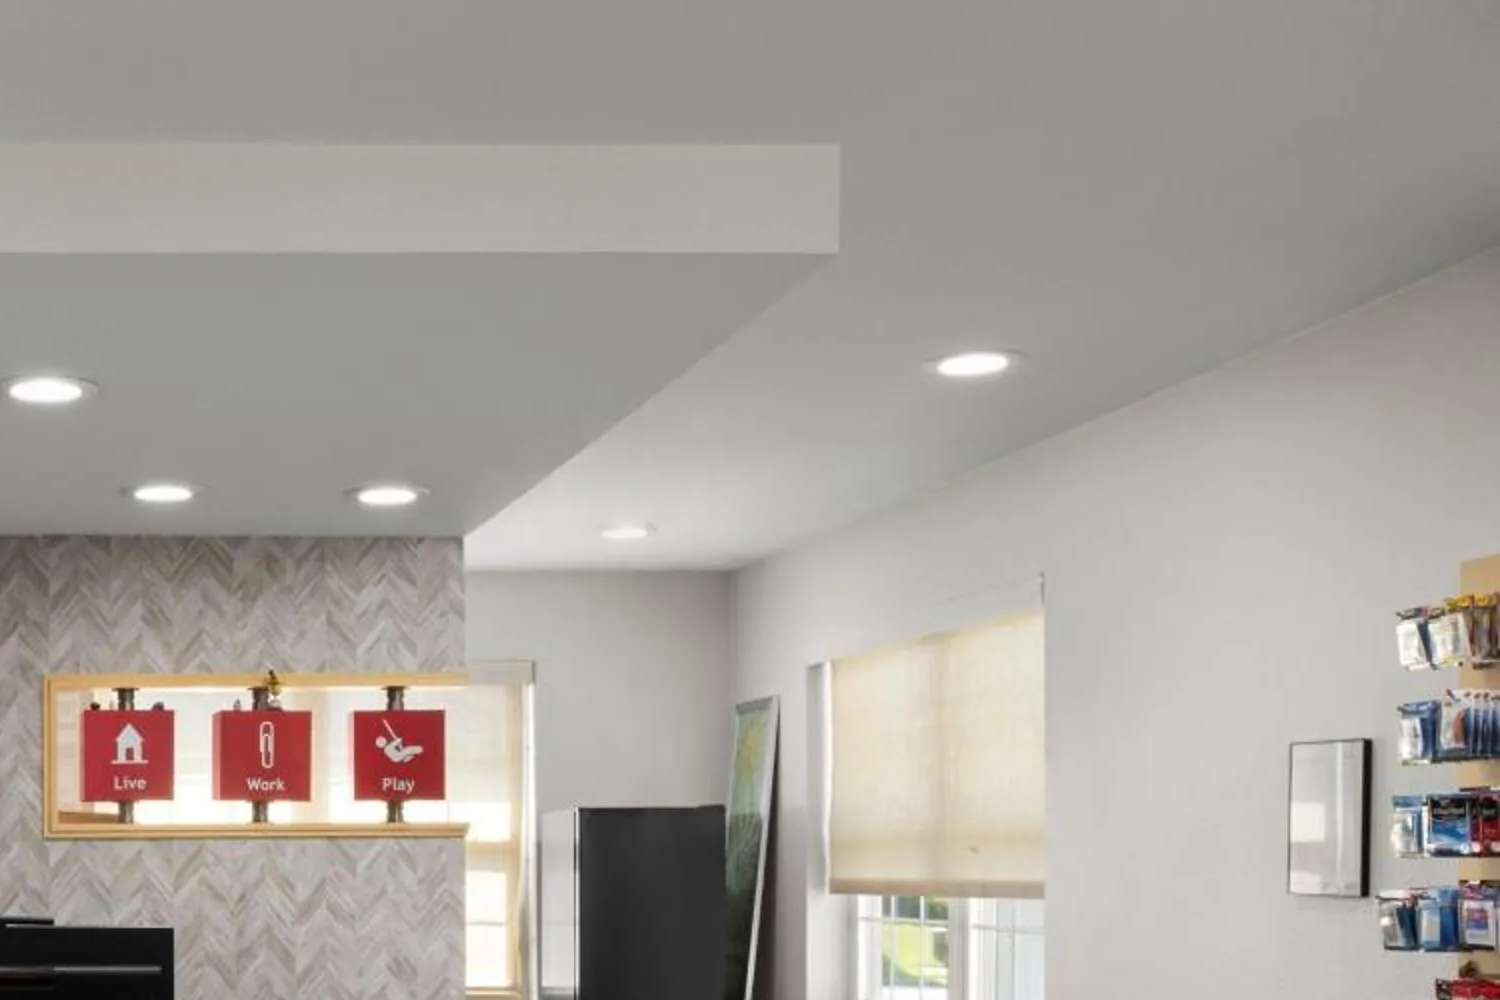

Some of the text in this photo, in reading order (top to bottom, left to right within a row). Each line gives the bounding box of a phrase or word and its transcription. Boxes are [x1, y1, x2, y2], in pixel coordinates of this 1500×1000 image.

[113, 776, 147, 791] Live
[246, 777, 285, 791] Work
[381, 777, 416, 795] Play
